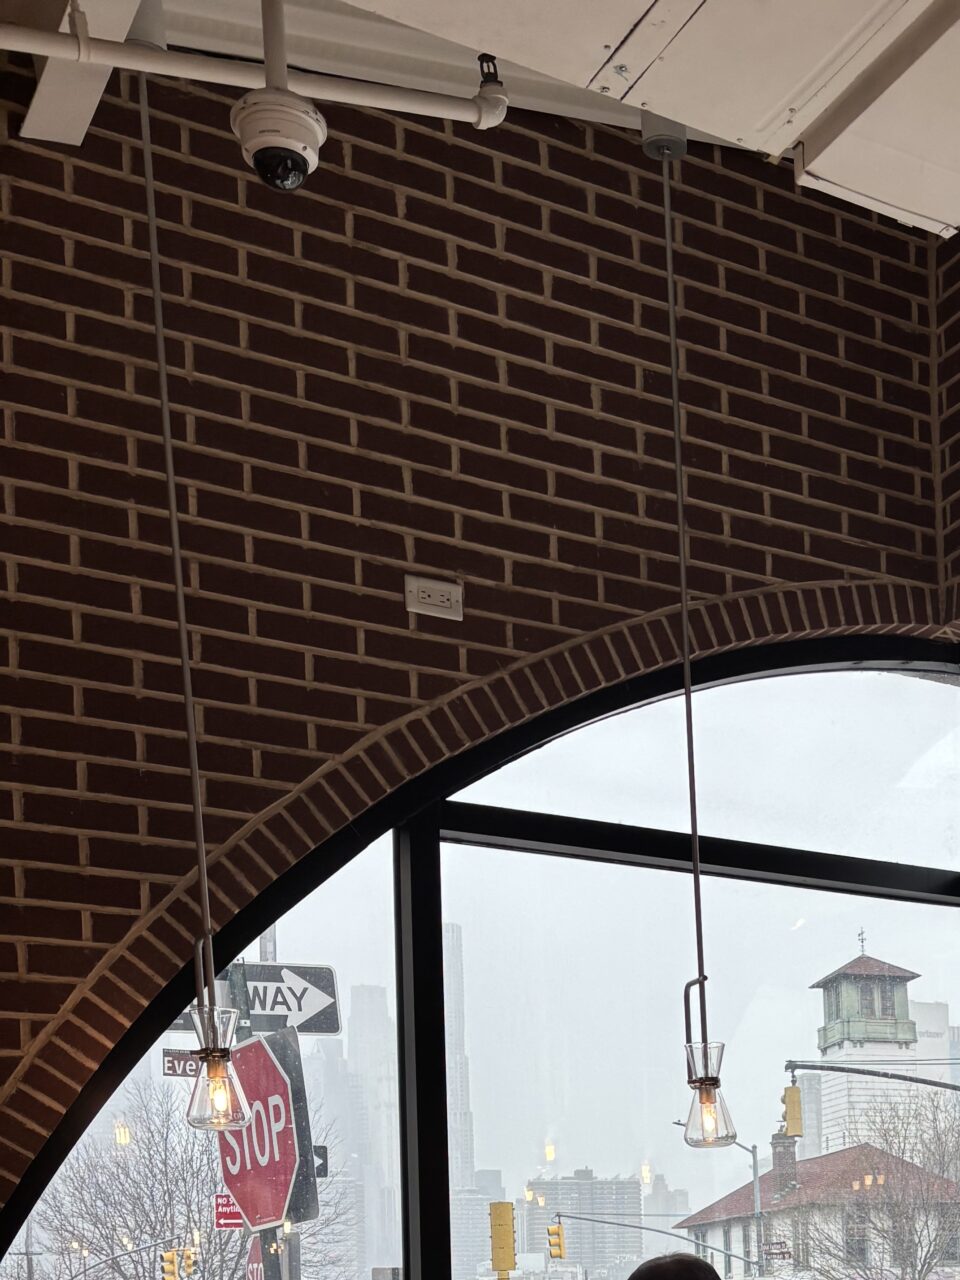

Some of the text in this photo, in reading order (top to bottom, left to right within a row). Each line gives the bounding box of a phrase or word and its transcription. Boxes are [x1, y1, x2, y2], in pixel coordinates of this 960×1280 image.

[249, 986, 309, 1012] WAY
[164, 1057, 197, 1075] Eve
[223, 1094, 286, 1175] STOP
[217, 1197, 228, 1205] NO
